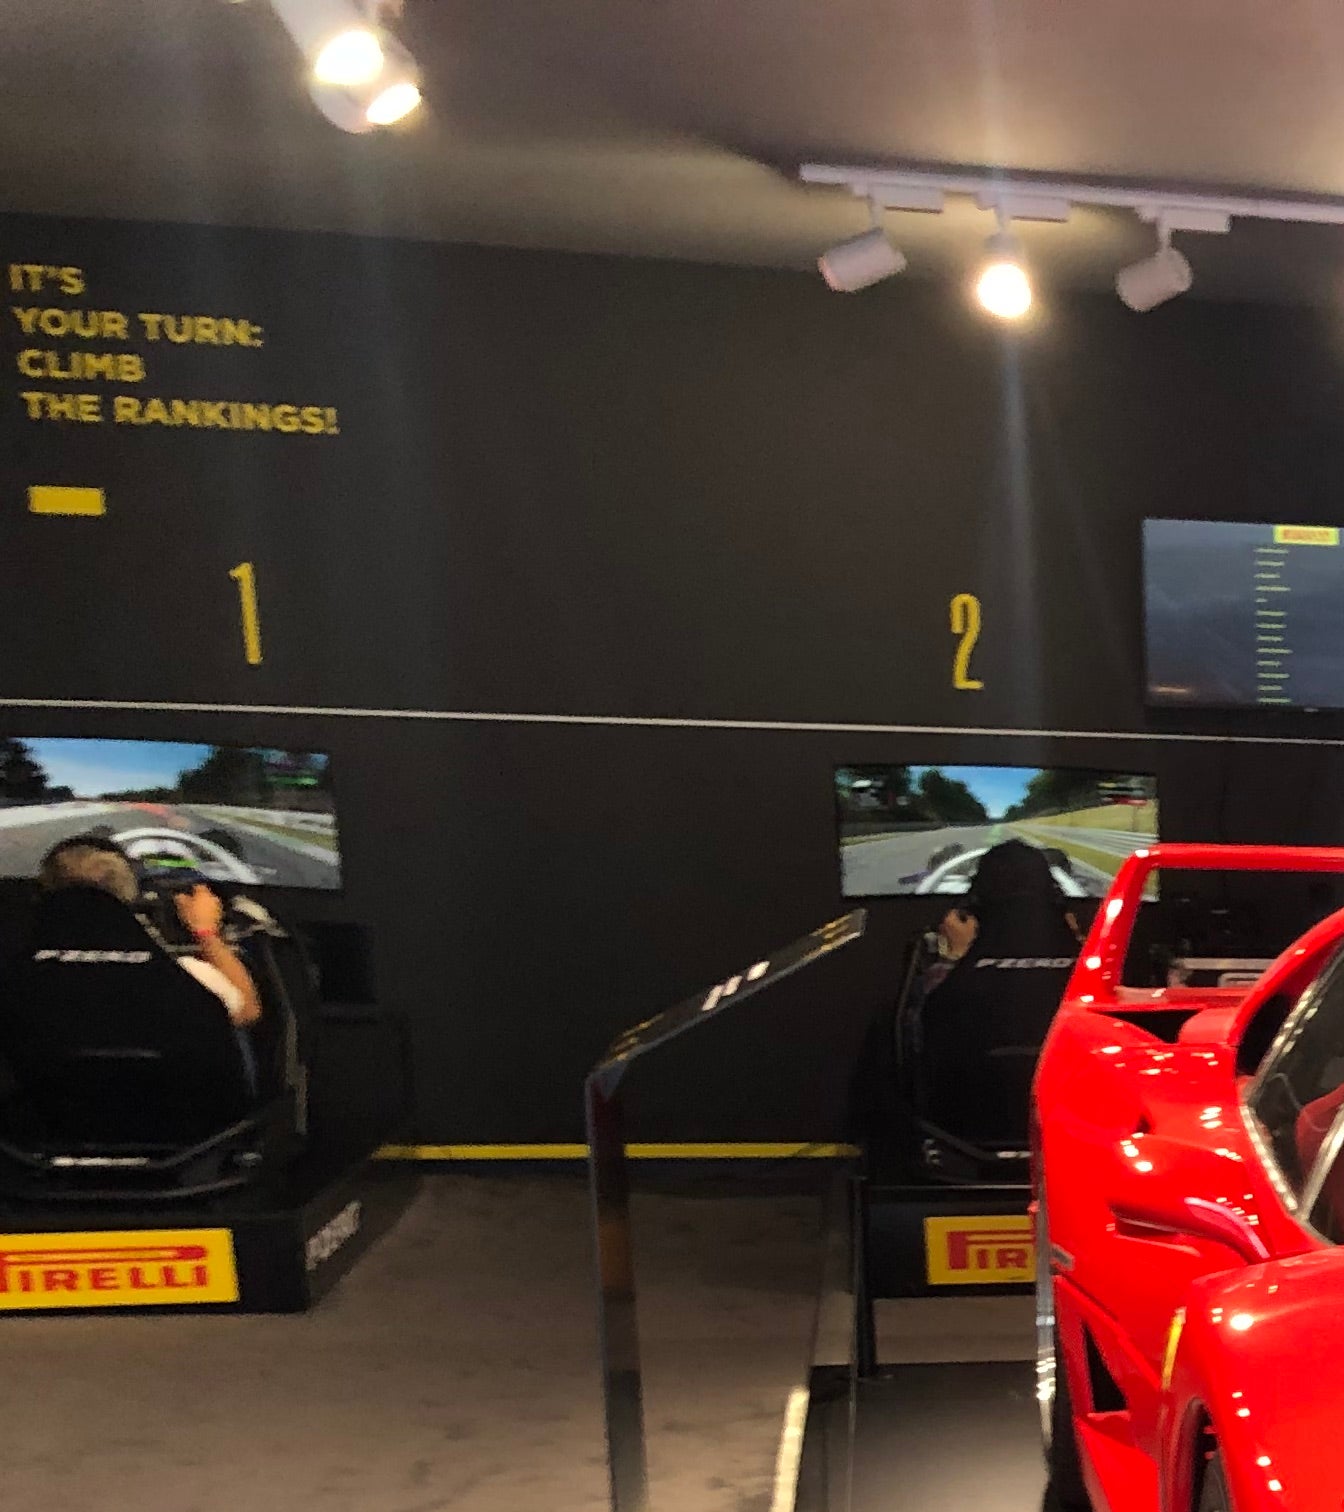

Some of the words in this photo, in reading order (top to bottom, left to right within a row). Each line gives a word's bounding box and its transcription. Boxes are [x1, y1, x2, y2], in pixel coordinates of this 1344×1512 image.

[9, 264, 86, 295] IT'S
[12, 307, 129, 340] YOUR
[138, 312, 264, 347] TURN:
[17, 349, 146, 382] CLIMB
[20, 391, 103, 423] THE
[114, 396, 340, 434] RANKINGS!
[228, 562, 263, 665] 1
[950, 593, 984, 690] 2
[946, 1229, 1038, 1270] PIR
